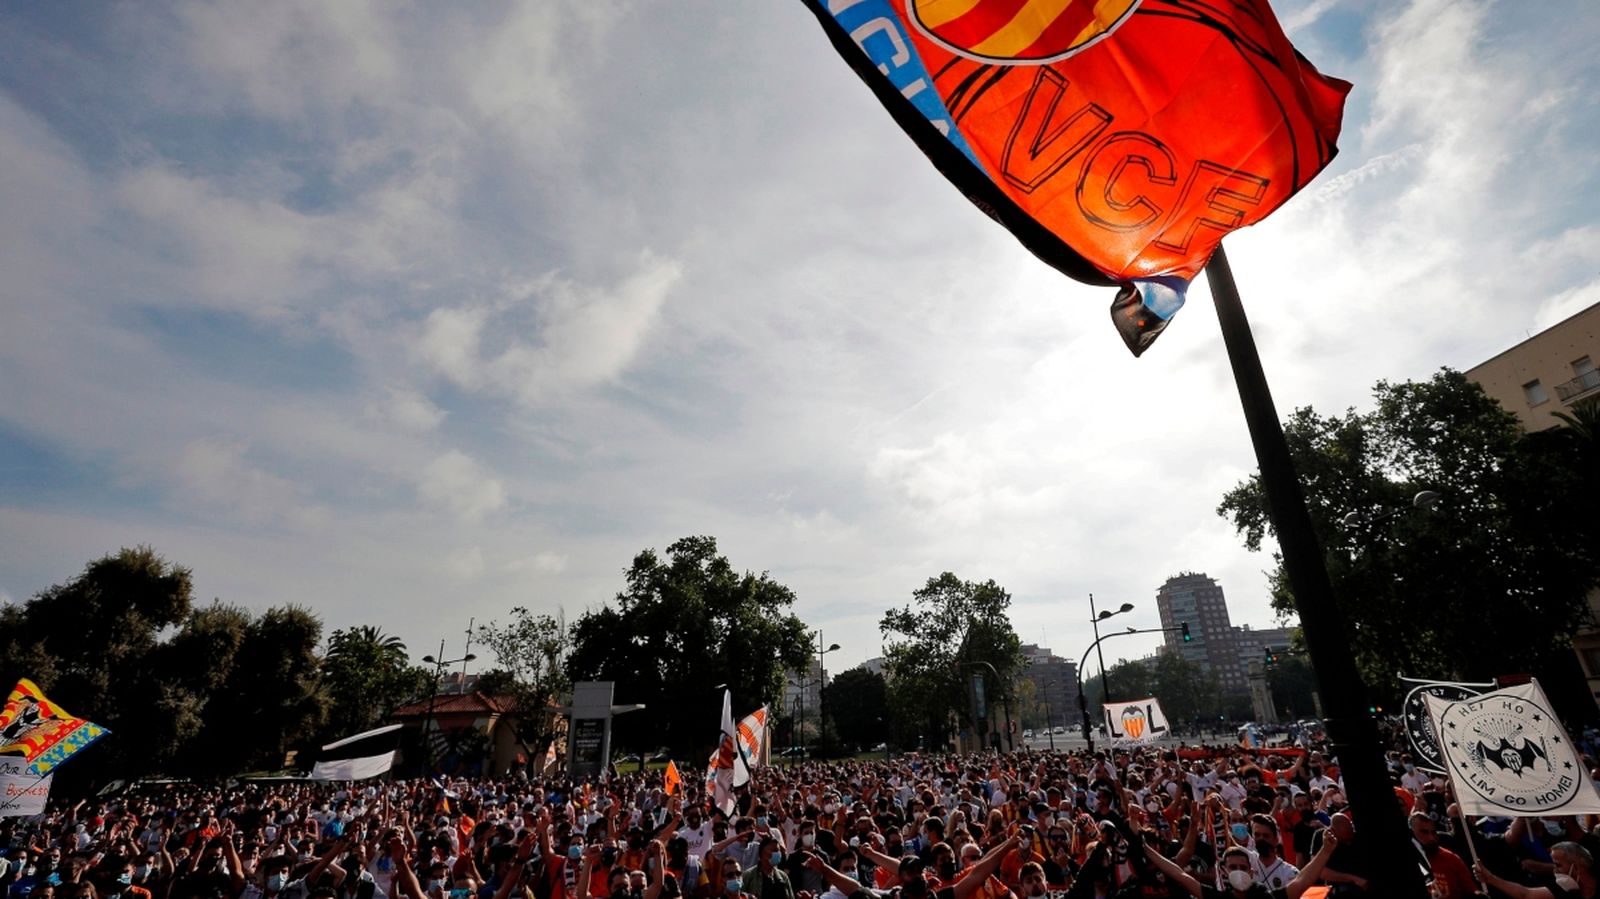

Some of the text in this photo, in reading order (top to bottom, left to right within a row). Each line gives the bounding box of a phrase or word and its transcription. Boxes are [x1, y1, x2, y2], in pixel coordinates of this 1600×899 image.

[1000, 65, 1271, 256] VCF
[1502, 701, 1525, 714] HO
[1418, 740, 1438, 758] LIM
[1469, 773, 1574, 806] LIM GO HOME!
